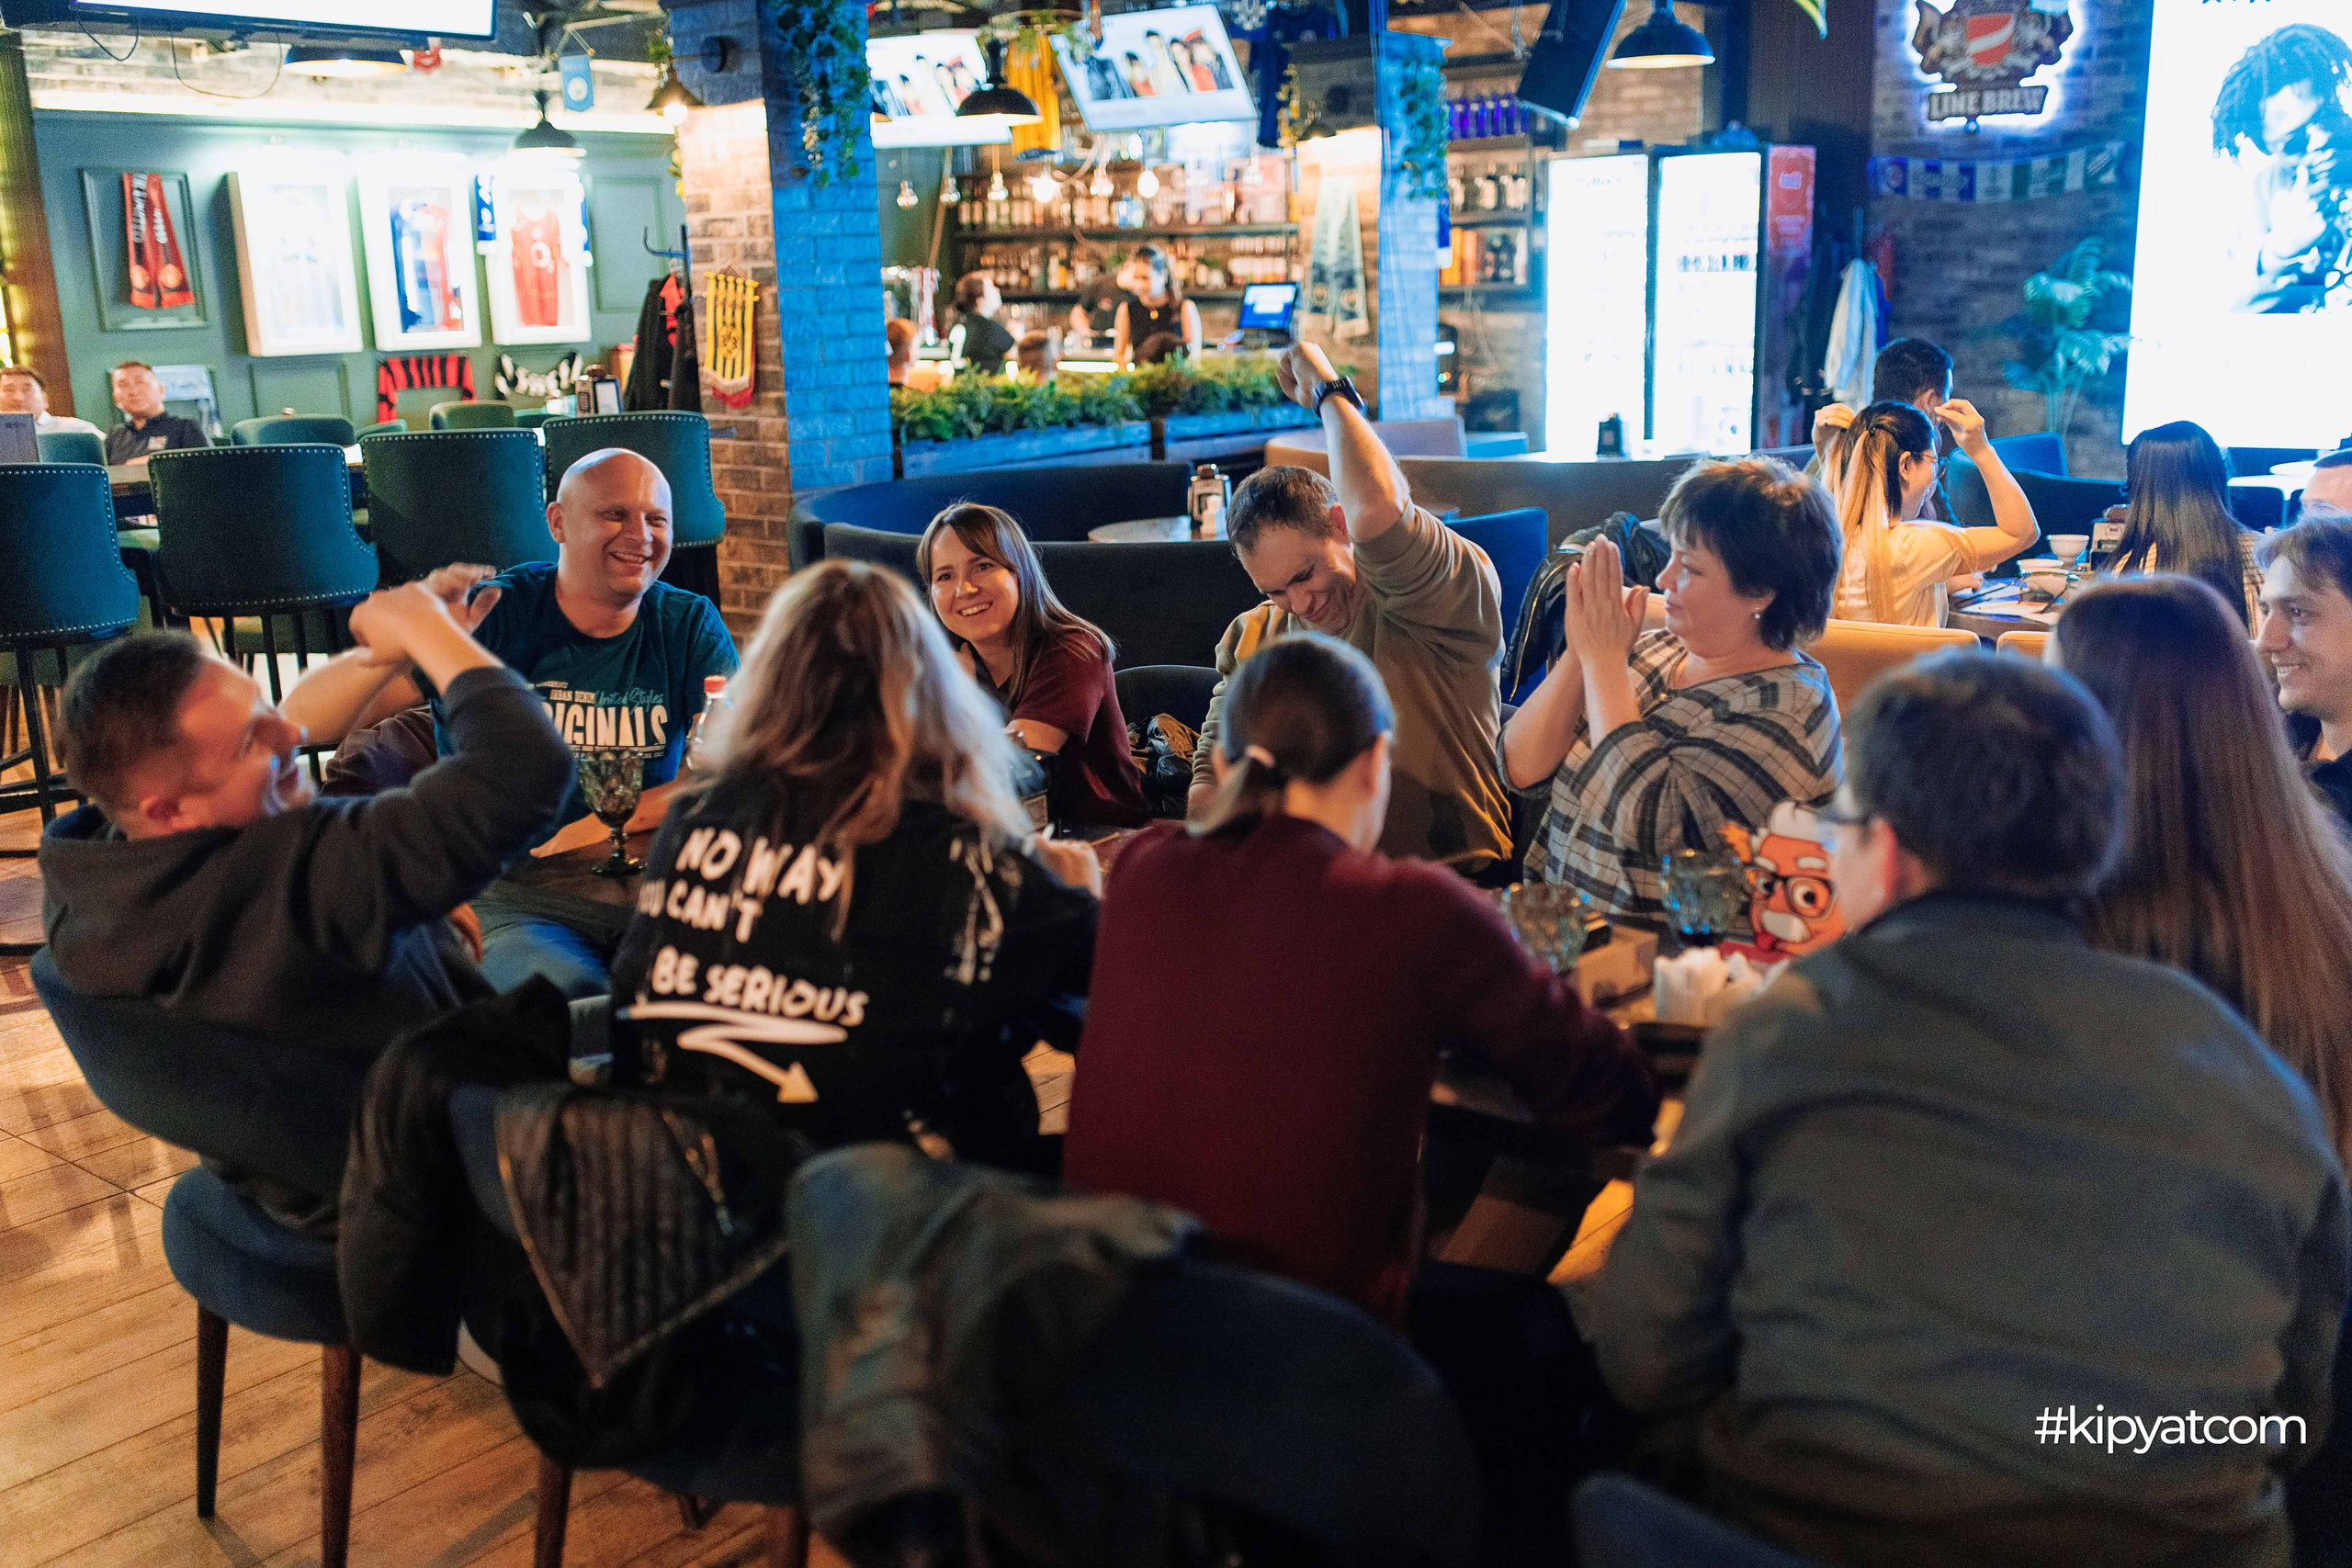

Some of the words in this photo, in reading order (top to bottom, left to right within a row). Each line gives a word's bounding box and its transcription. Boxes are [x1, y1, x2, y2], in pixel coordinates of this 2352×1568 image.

[676, 826, 742, 882] NO
[742, 836, 846, 906] WAY
[651, 944, 700, 996] BE
[703, 964, 870, 1028] SERIOUS
